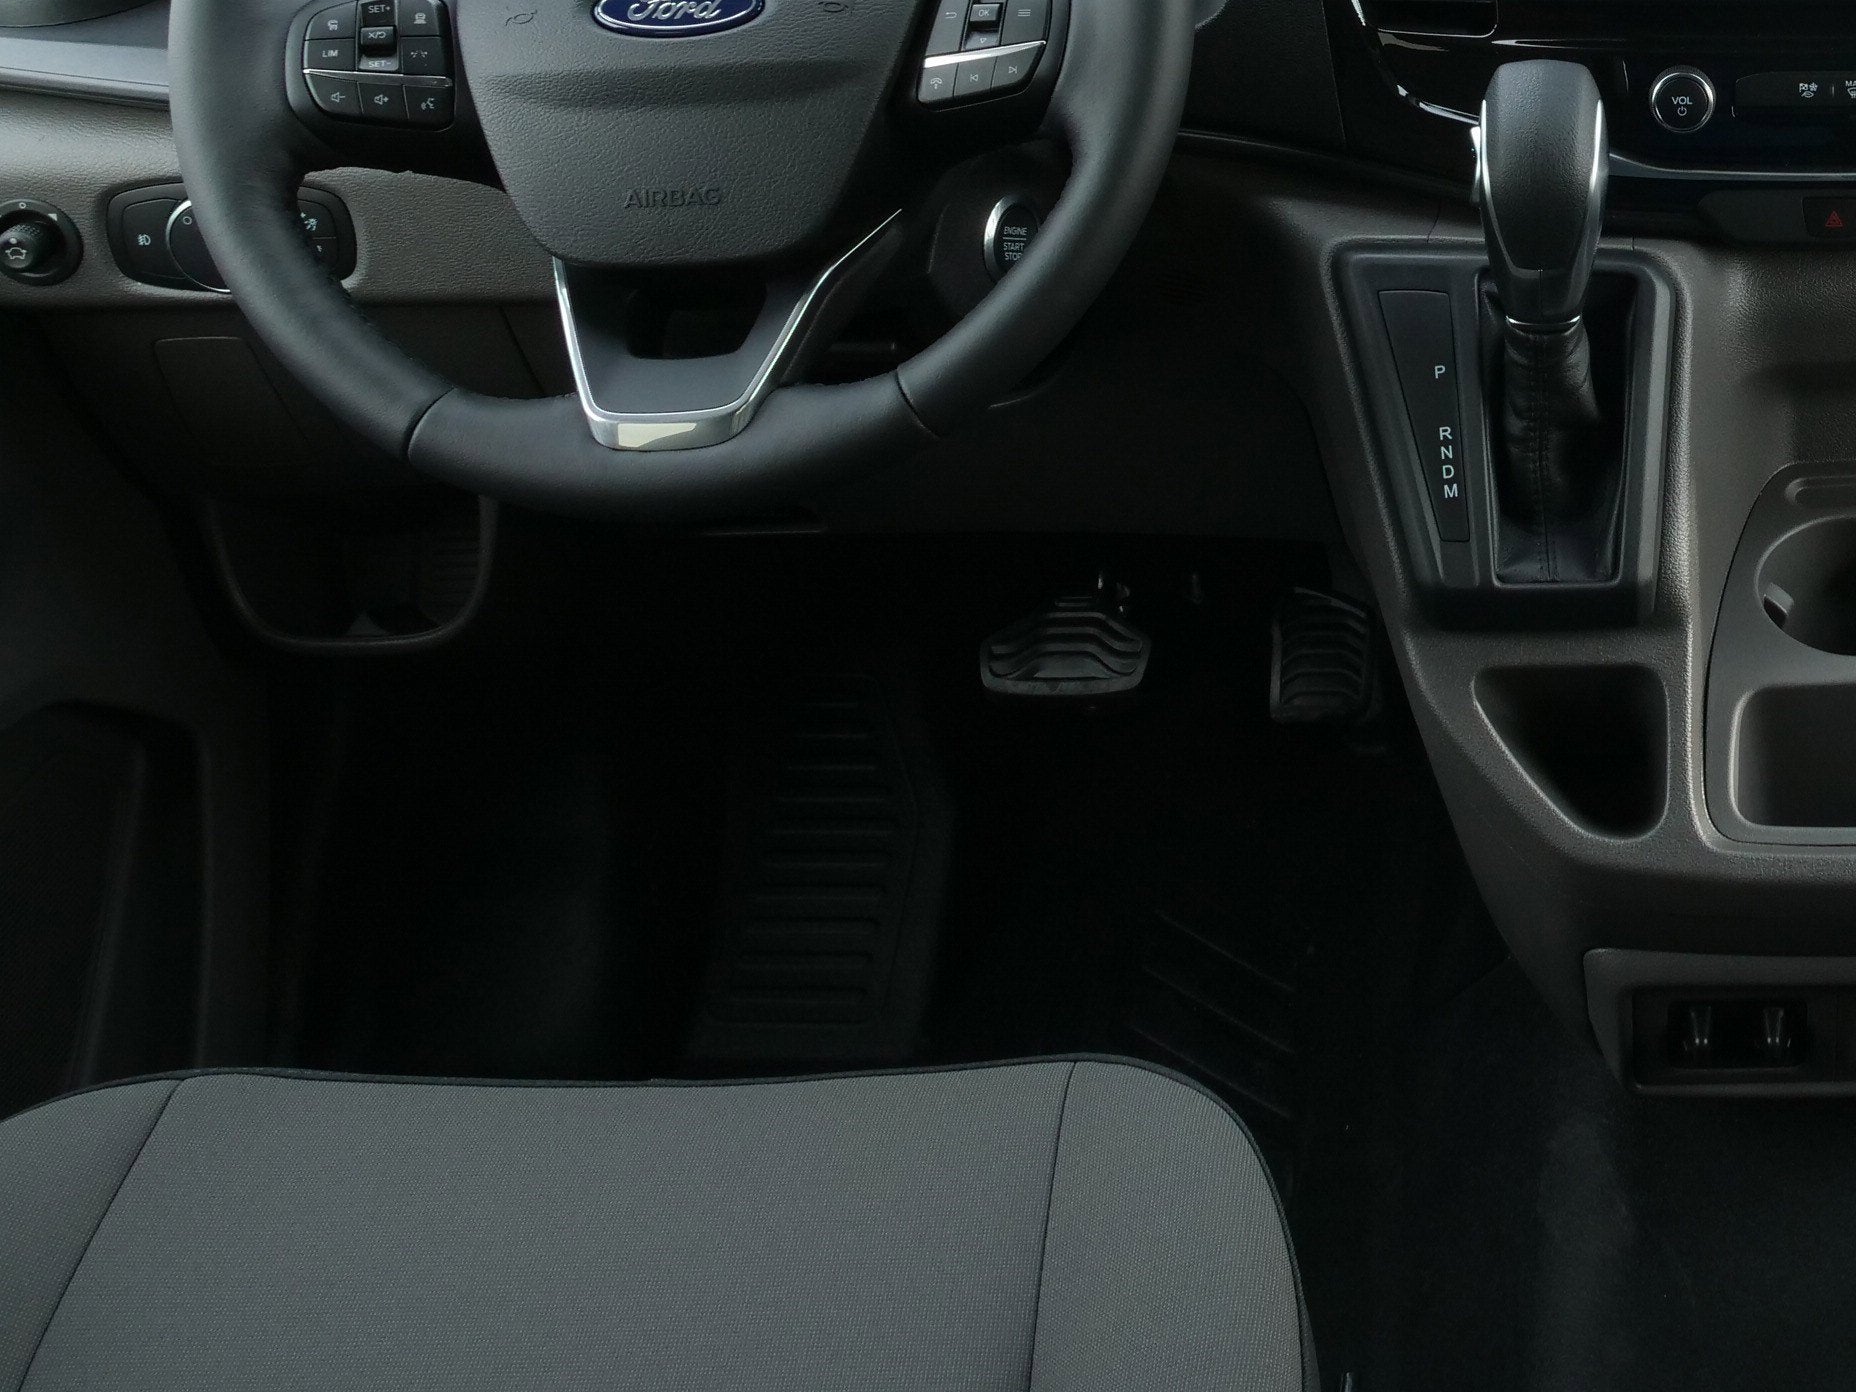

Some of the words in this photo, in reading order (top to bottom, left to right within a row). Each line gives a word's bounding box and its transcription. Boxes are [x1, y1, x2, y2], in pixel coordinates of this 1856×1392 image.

[978, 9, 990, 18] OK
[322, 49, 338, 58] LIM
[1671, 95, 1693, 106] VOL
[624, 187, 721, 209] AIRBAG
[1003, 226, 1029, 236] ENGINE
[1003, 242, 1025, 251] START
[1434, 364, 1447, 379] P
[1439, 426, 1453, 441] R
[1440, 445, 1454, 460] N
[1442, 464, 1455, 480] D
[1444, 483, 1459, 499] M
